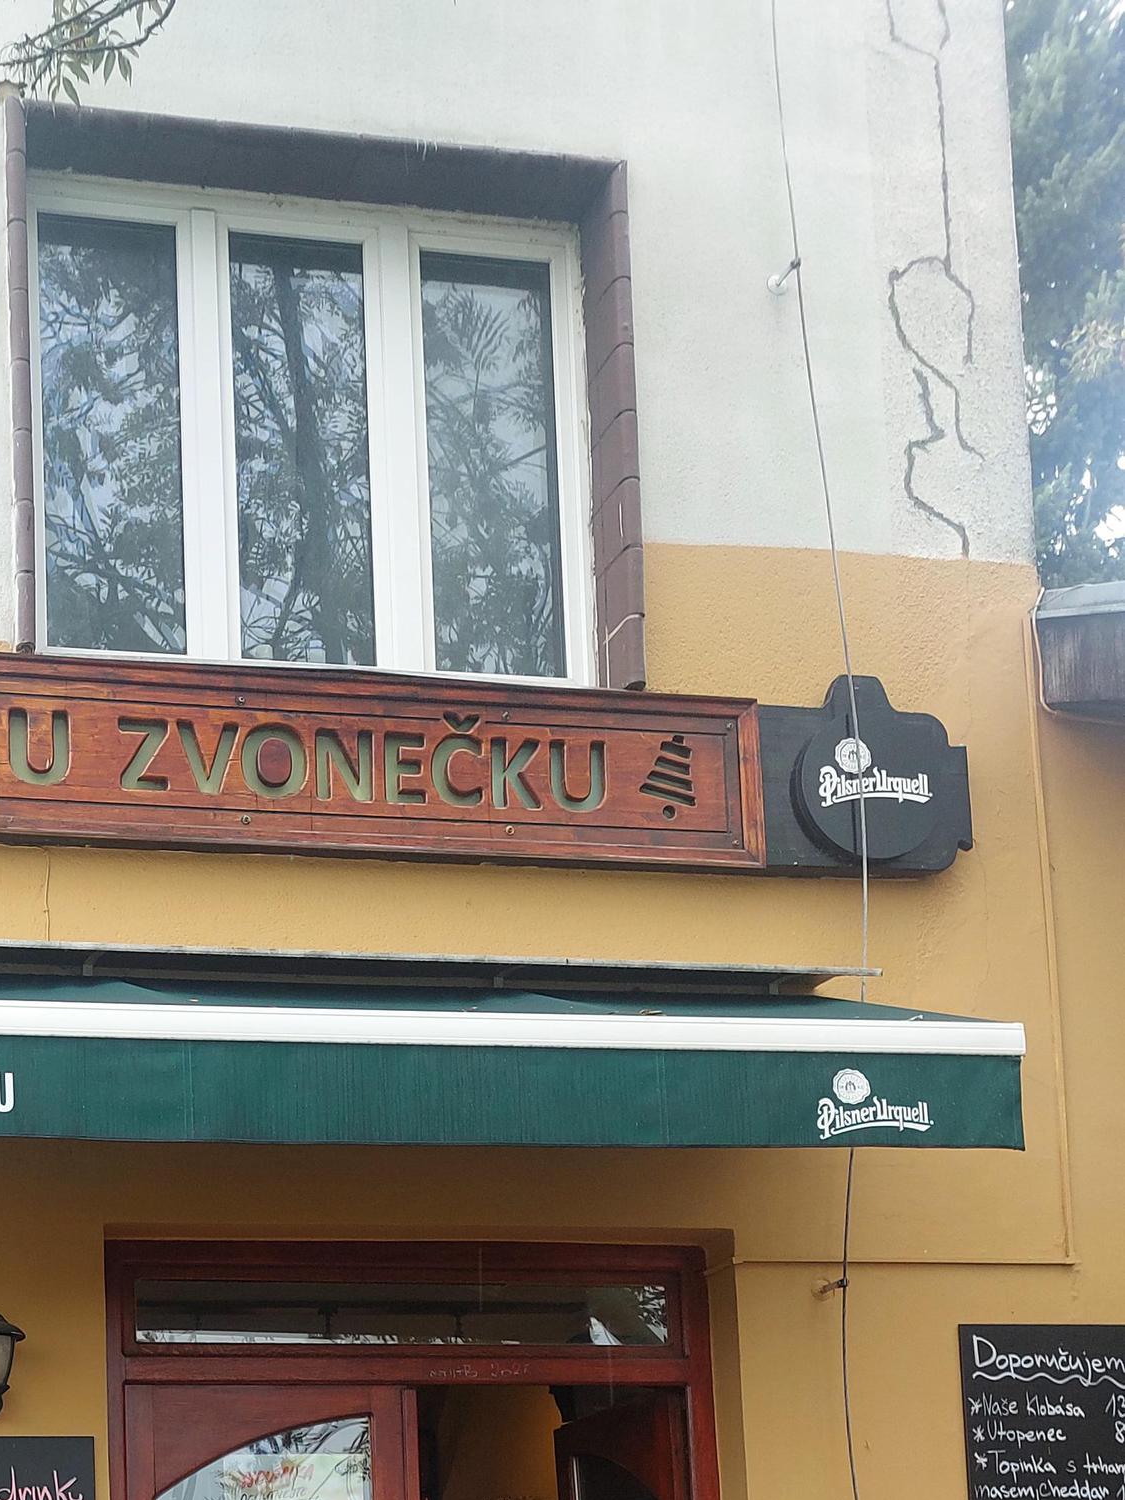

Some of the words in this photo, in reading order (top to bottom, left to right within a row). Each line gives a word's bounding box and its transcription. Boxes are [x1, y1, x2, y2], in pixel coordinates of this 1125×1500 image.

[6, 706, 71, 787] U
[116, 710, 608, 814] ZVONEČKU
[818, 765, 876, 807] Pilsner
[817, 1097, 876, 1140] Pilsner
[986, 1419, 1067, 1449] Utopenec
[987, 1450, 1056, 1483] Topinka
